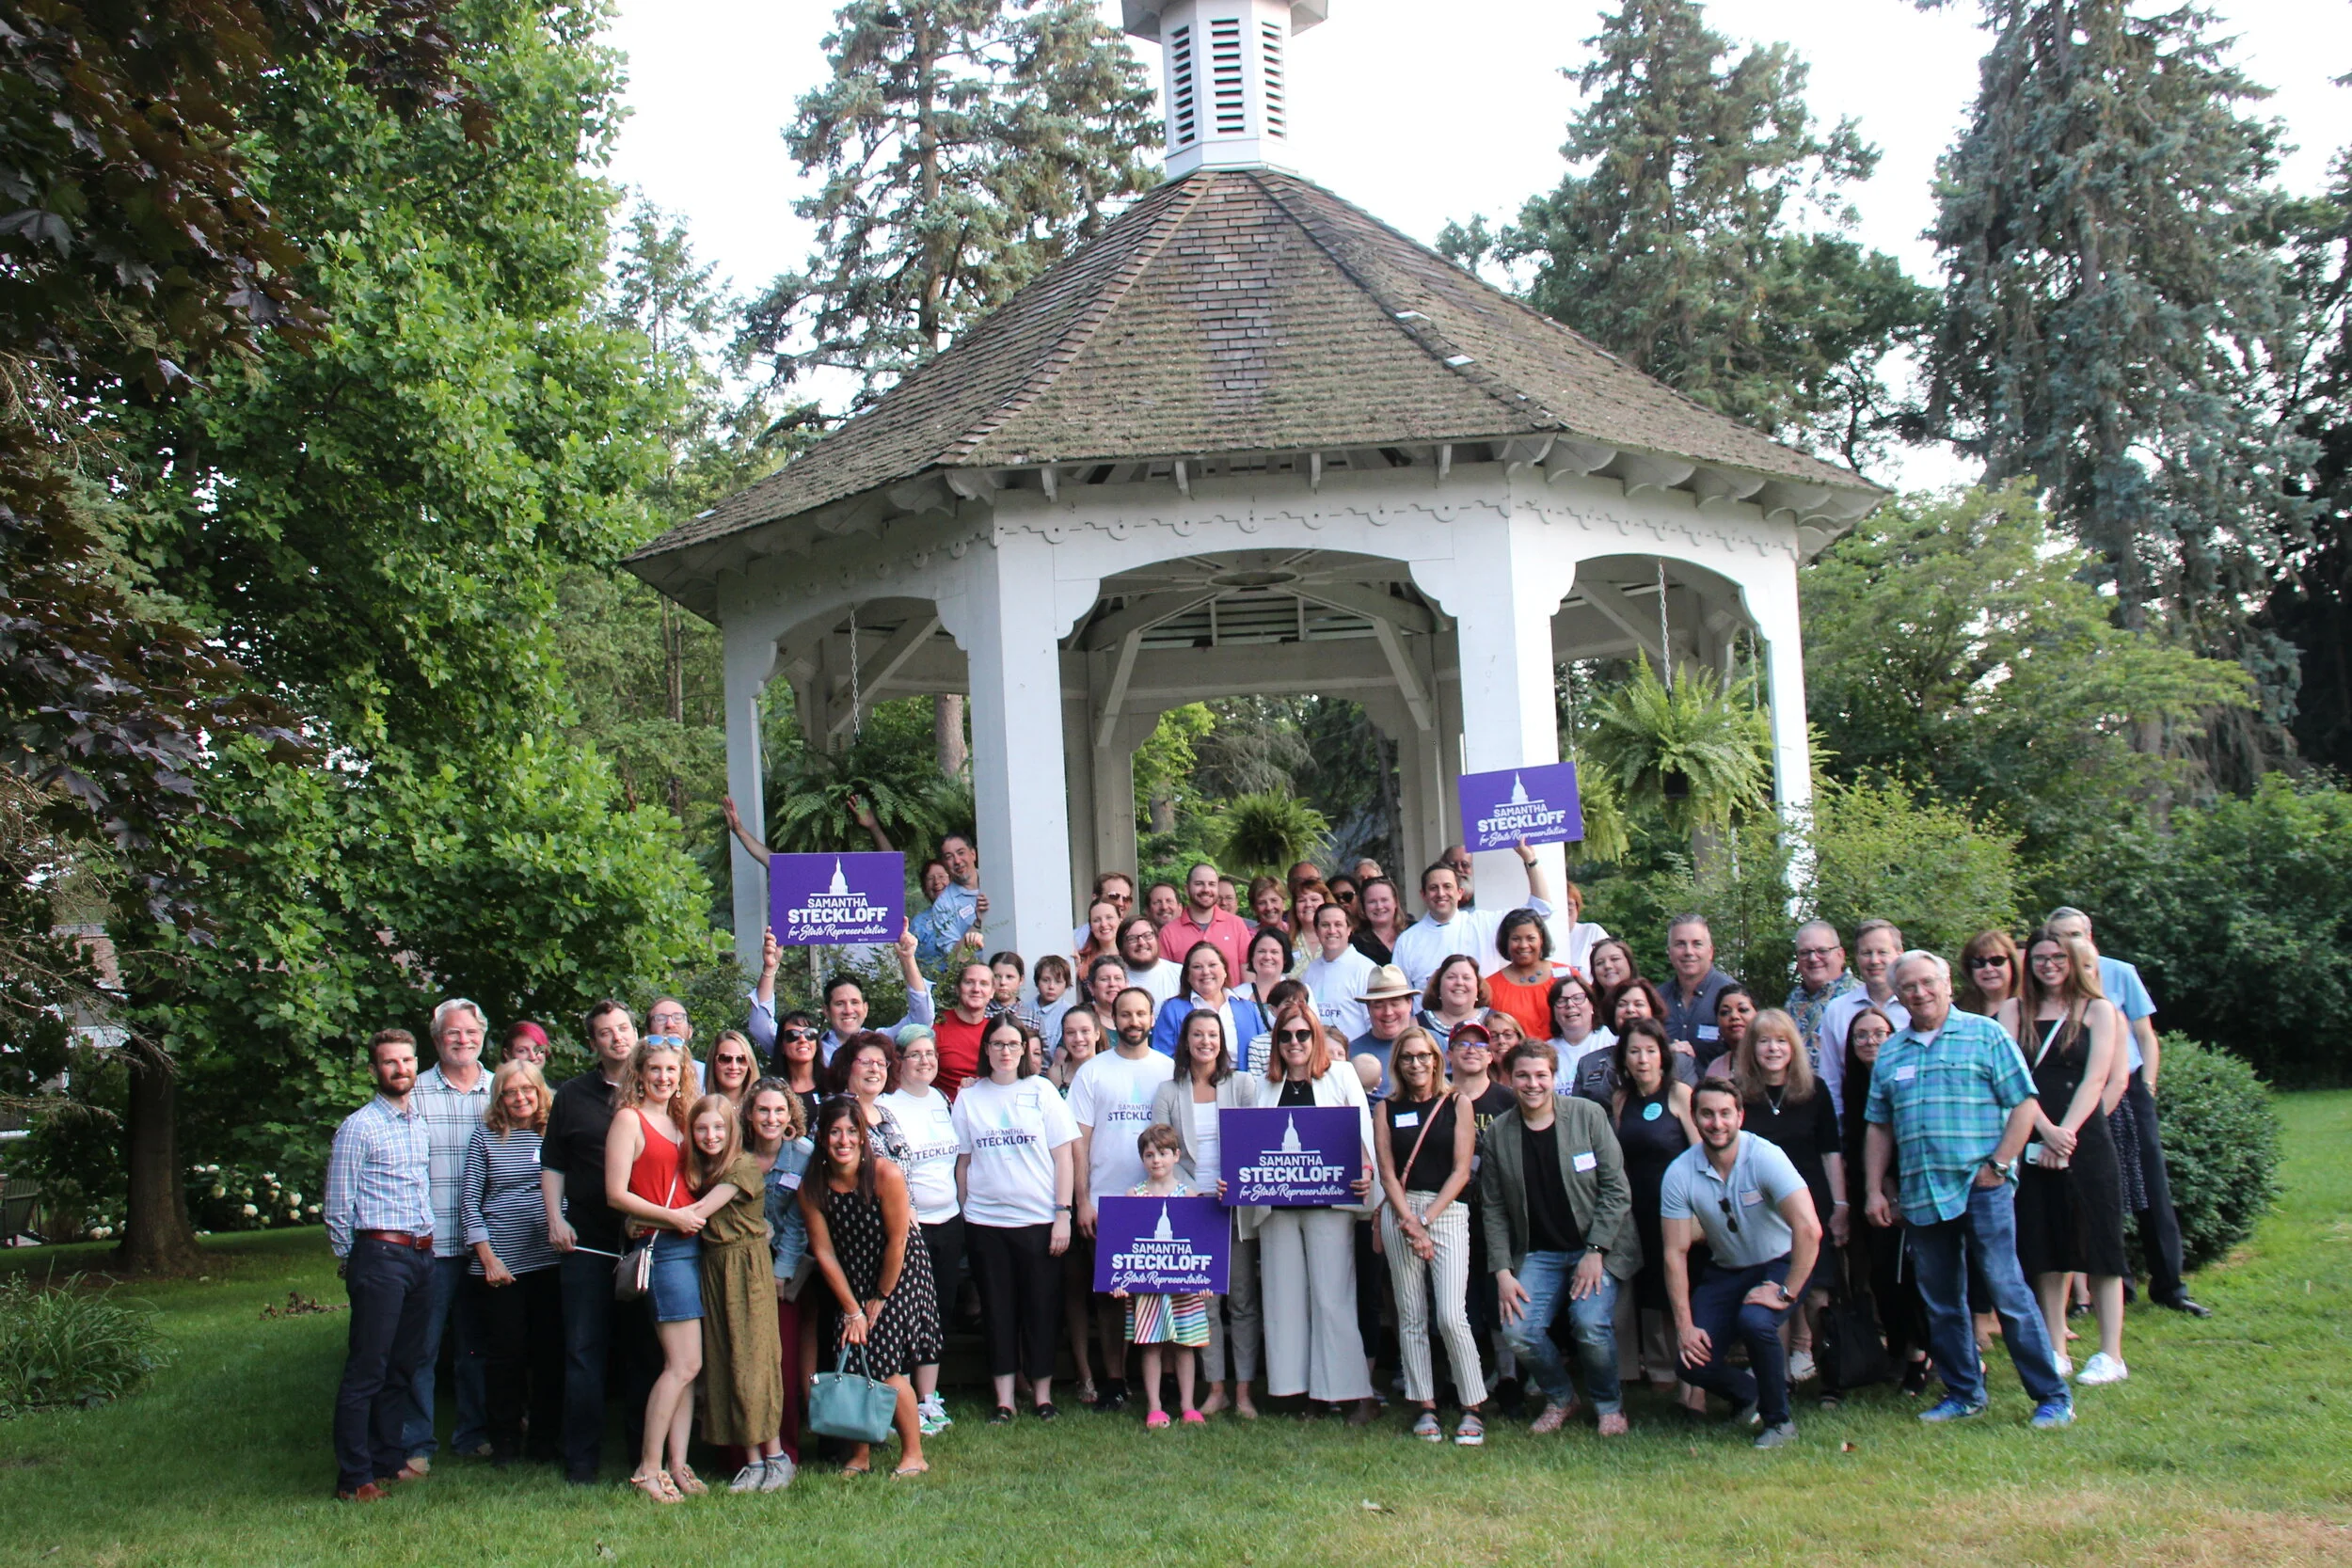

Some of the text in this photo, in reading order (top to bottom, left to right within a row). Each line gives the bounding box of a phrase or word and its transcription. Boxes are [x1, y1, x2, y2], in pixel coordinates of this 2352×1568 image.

[1494, 803, 1548, 817] SAMANTHA
[1477, 810, 1565, 832] STECKLOFF
[1479, 834, 1489, 846] for
[1488, 832, 1511, 847] State
[807, 897, 868, 909] SAMANTHA
[787, 907, 888, 924] STECKLOFF
[787, 924, 888, 941] for State Representative
[1107, 1111, 1152, 1121] STECKLO
[976, 1134, 1037, 1148] STECKLOFF
[914, 1144, 960, 1161] TECKLOF
[1259, 1155, 1324, 1166] SAMANTHA
[1239, 1166, 1345, 1183] STECKLOFF
[1239, 1182, 1346, 1202] for State Representative
[1132, 1243, 1193, 1255] SAMANTHA
[1111, 1254, 1213, 1271] STECKLOFF
[1111, 1271, 1212, 1290] for State Representative
